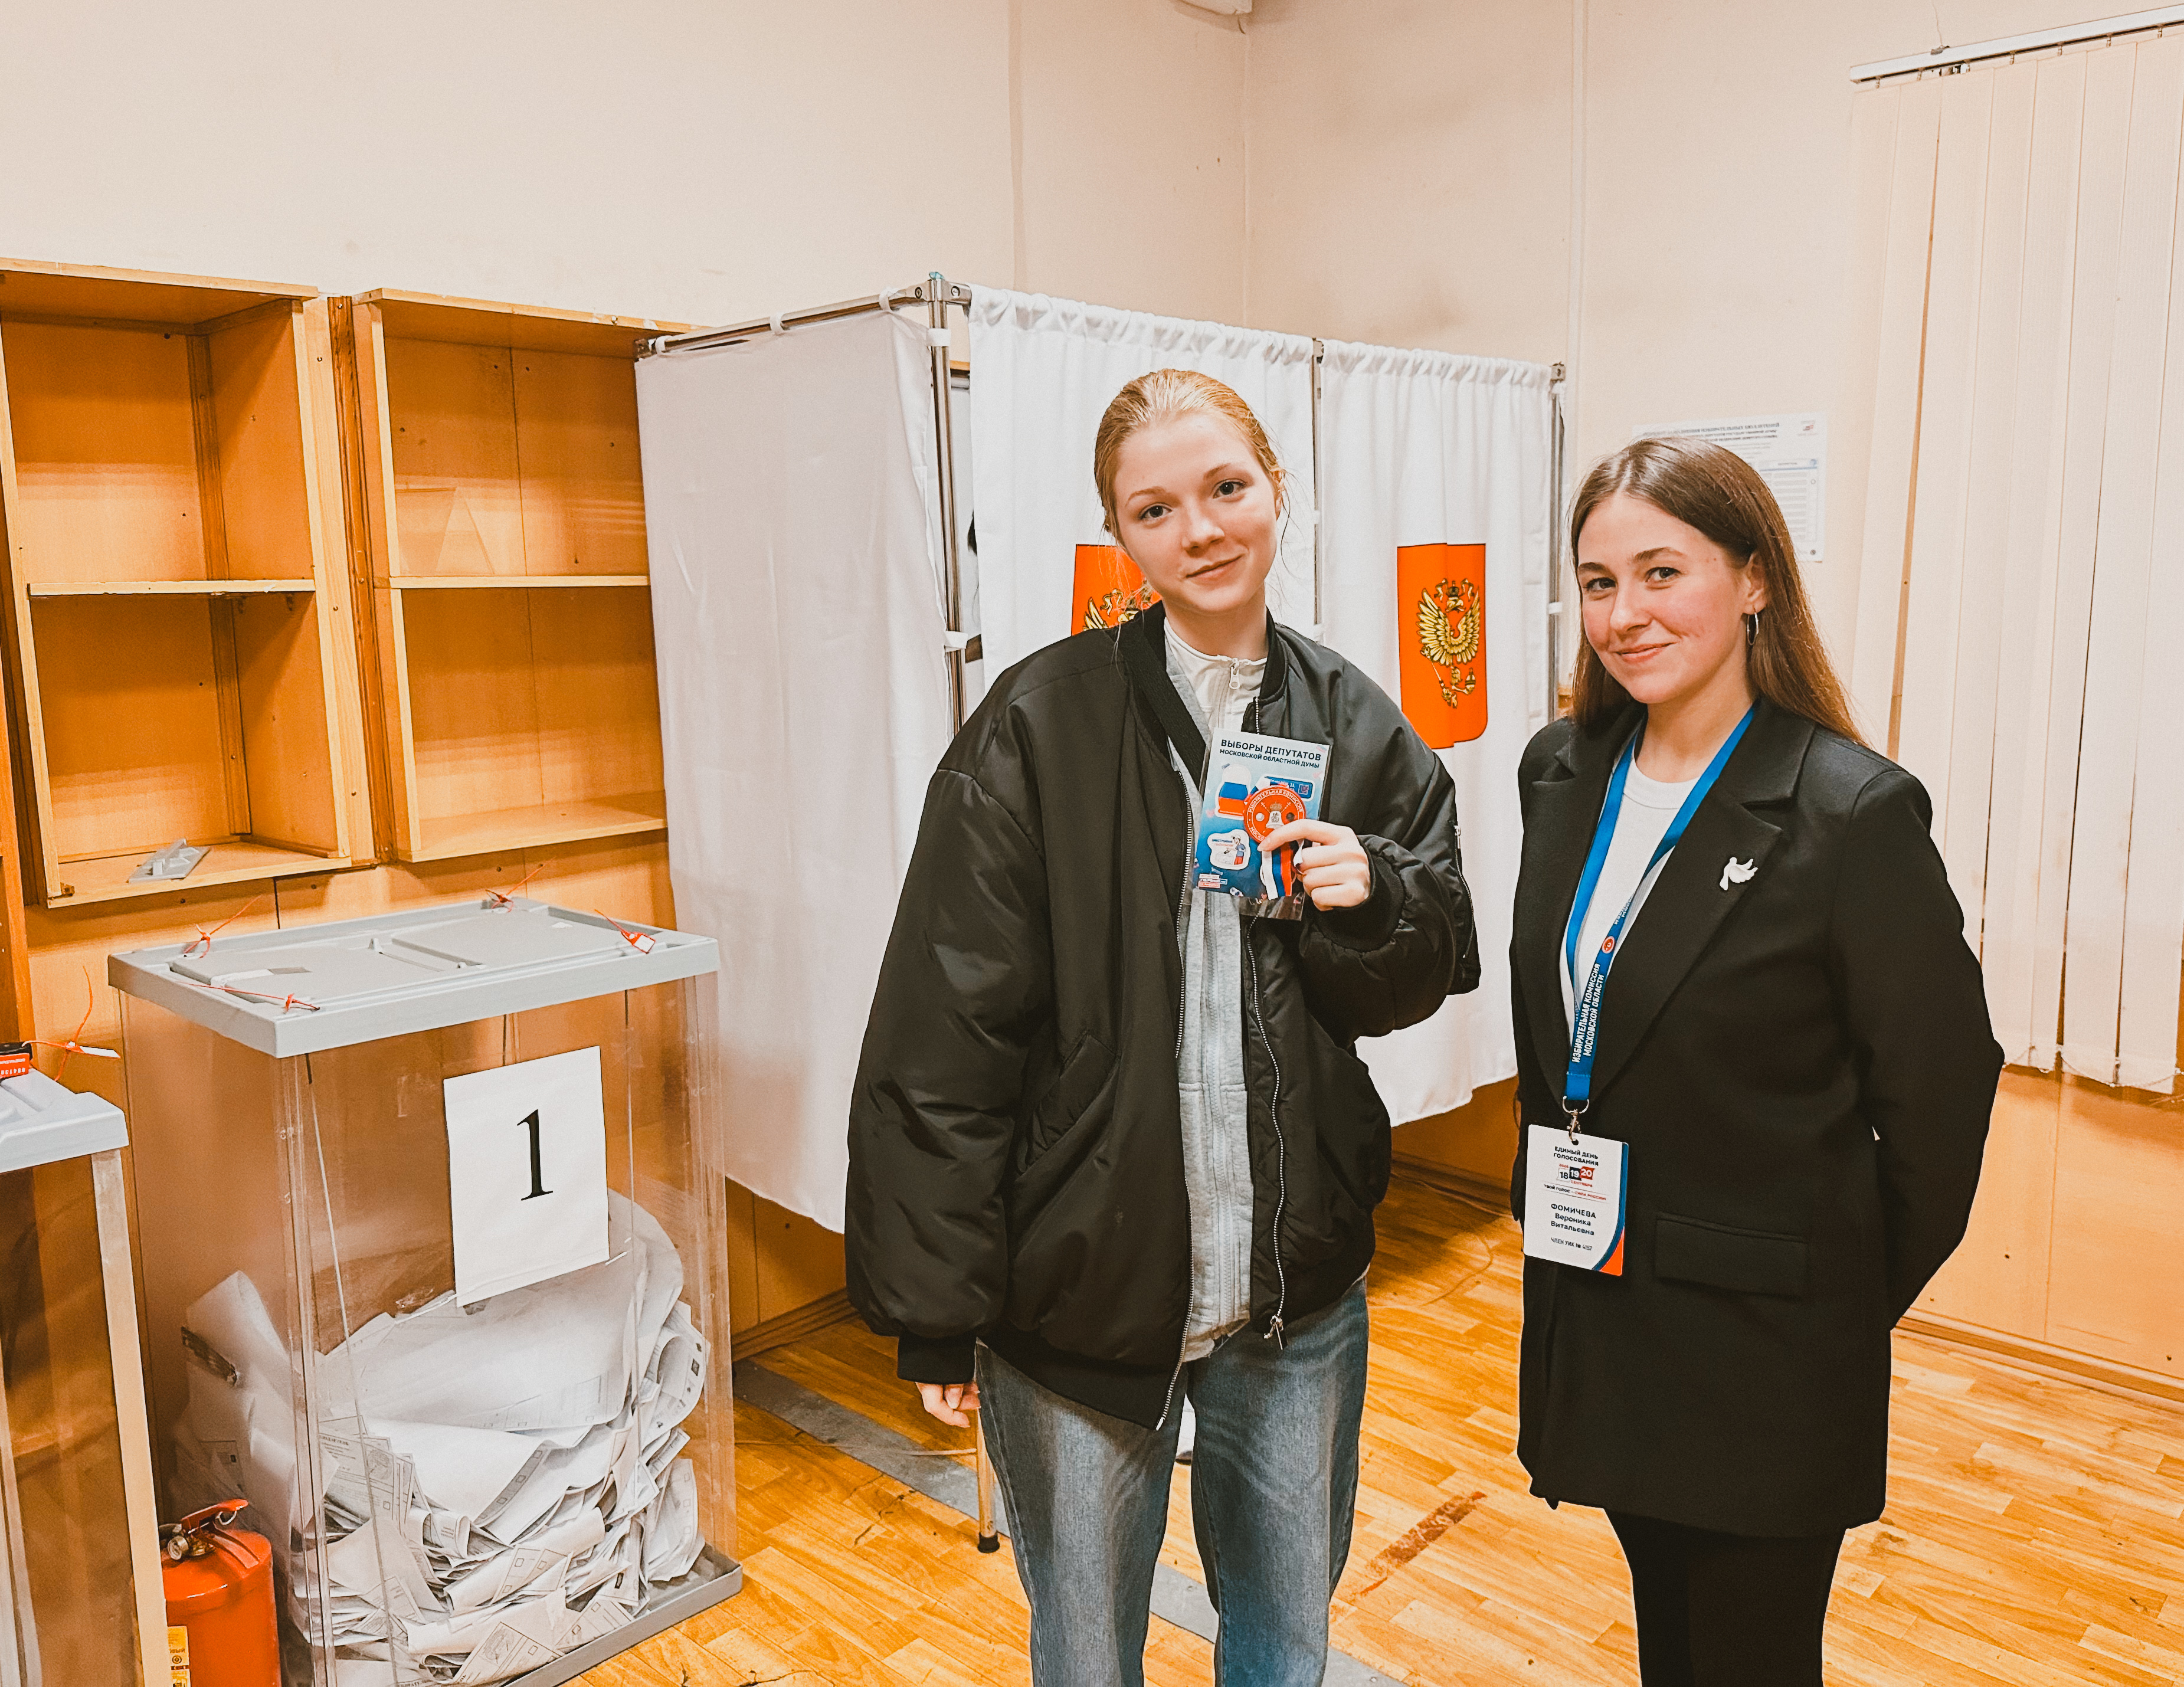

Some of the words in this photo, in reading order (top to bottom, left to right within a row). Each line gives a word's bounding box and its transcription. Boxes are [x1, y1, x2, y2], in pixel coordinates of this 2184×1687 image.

[1219, 749, 1262, 759] МОСКОВСКОЙ
[1263, 755, 1300, 765] ОБЛАСТНОЙ
[1221, 739, 1263, 752] ВЫБОРЫ
[1265, 746, 1321, 761] ДЕПУТАТОВ
[1249, 826, 1266, 841] МОСКО
[1571, 1003, 1590, 1063] ИЗБИРАТЕЛЬНАЯ
[1584, 963, 1600, 1003] КОМИССИЯ
[1583, 1007, 1598, 1056] МОСКОВСКОЙ
[1592, 974, 1605, 1007] ОБЛАСТИ
[517, 1109, 553, 1201] 1
[1554, 1146, 1580, 1155] ЕДИНЫЙ
[1553, 1152, 1599, 1166] ГОЛОСОВАНИЯ
[1570, 1170, 1580, 1178] 19
[1581, 1168, 1592, 1177] 20
[1551, 1203, 1596, 1218] ФОМИЧЕВА
[1555, 1213, 1591, 1226] Вероника
[1551, 1220, 1594, 1235] Витальевна
